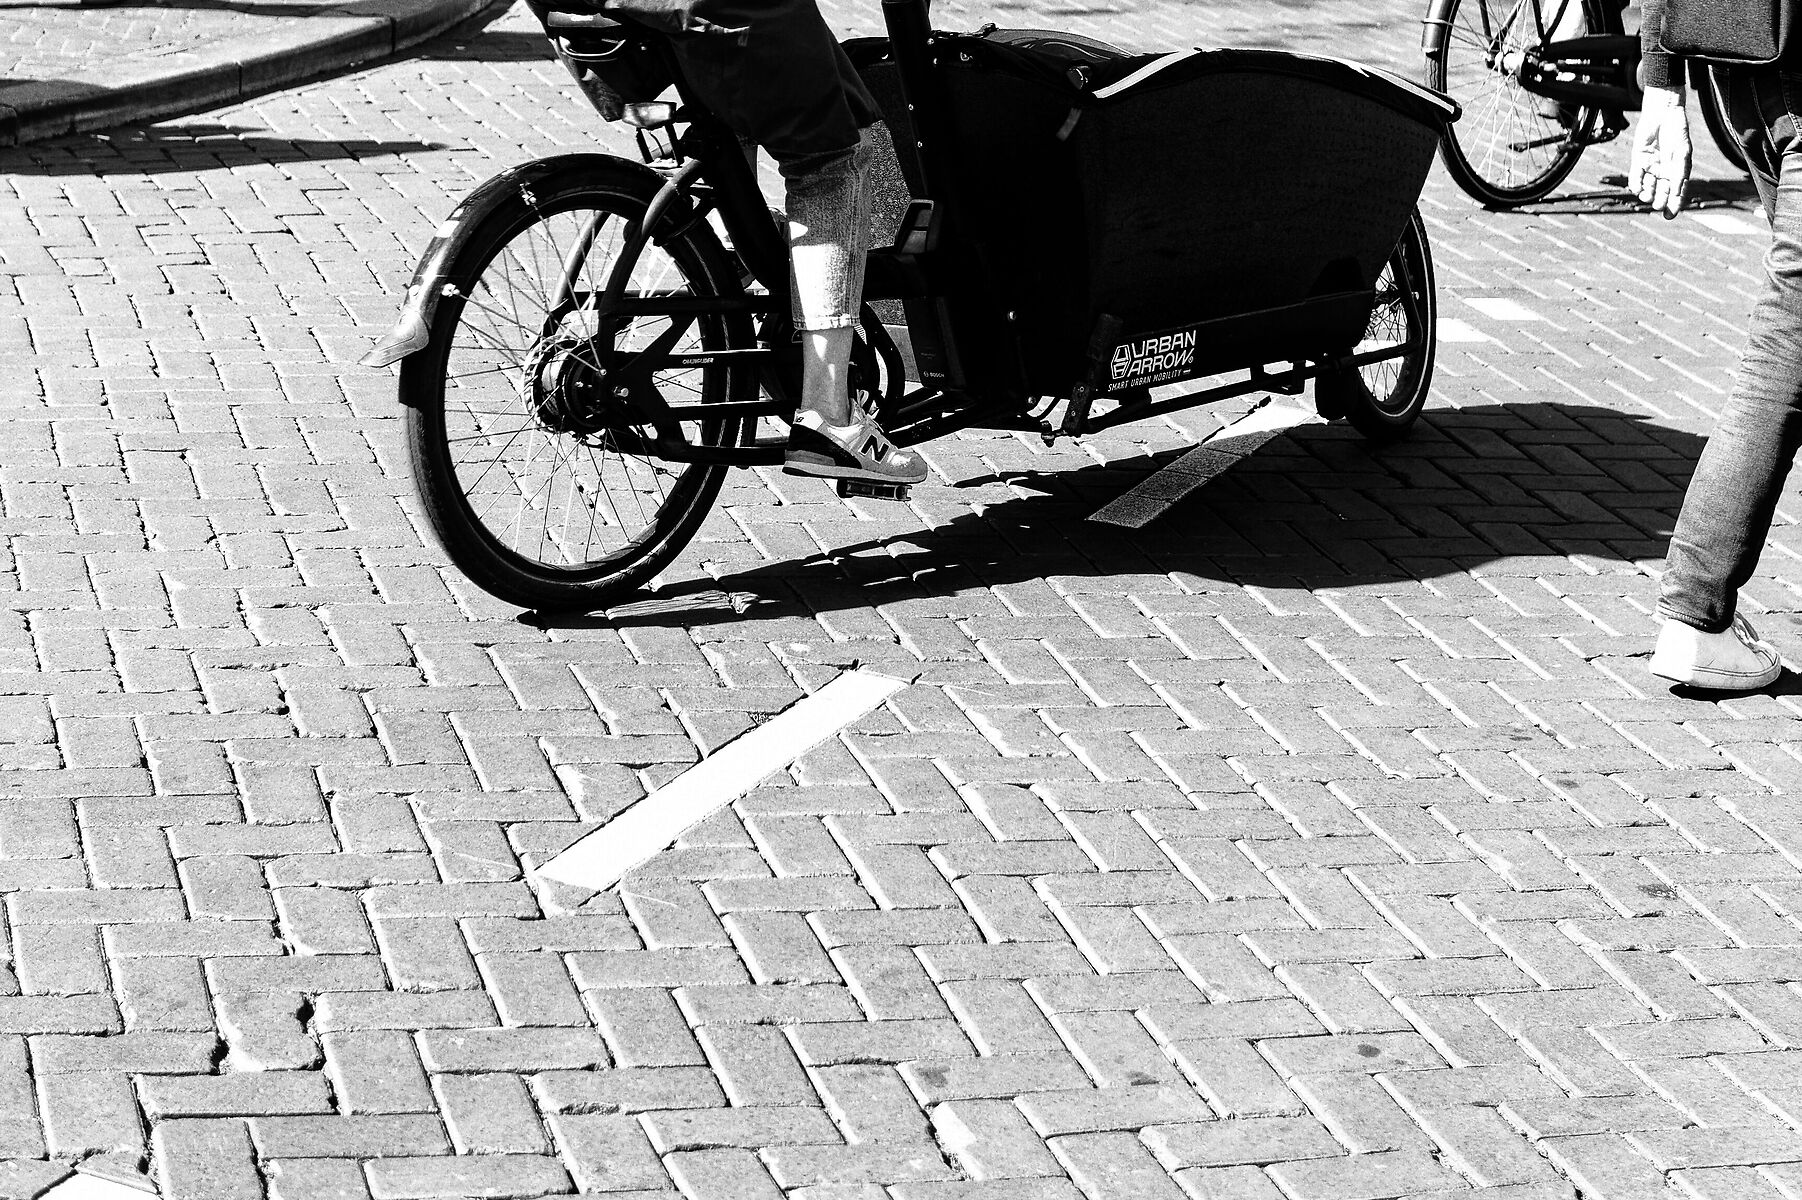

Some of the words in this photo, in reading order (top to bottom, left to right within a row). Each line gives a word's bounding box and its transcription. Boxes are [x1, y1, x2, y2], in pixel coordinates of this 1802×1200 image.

[1131, 330, 1196, 358] URBAN
[1108, 380, 1129, 392] SMART
[1130, 376, 1152, 387] URBAN
[1153, 369, 1182, 382] MOBILITY
[859, 434, 890, 464] N
